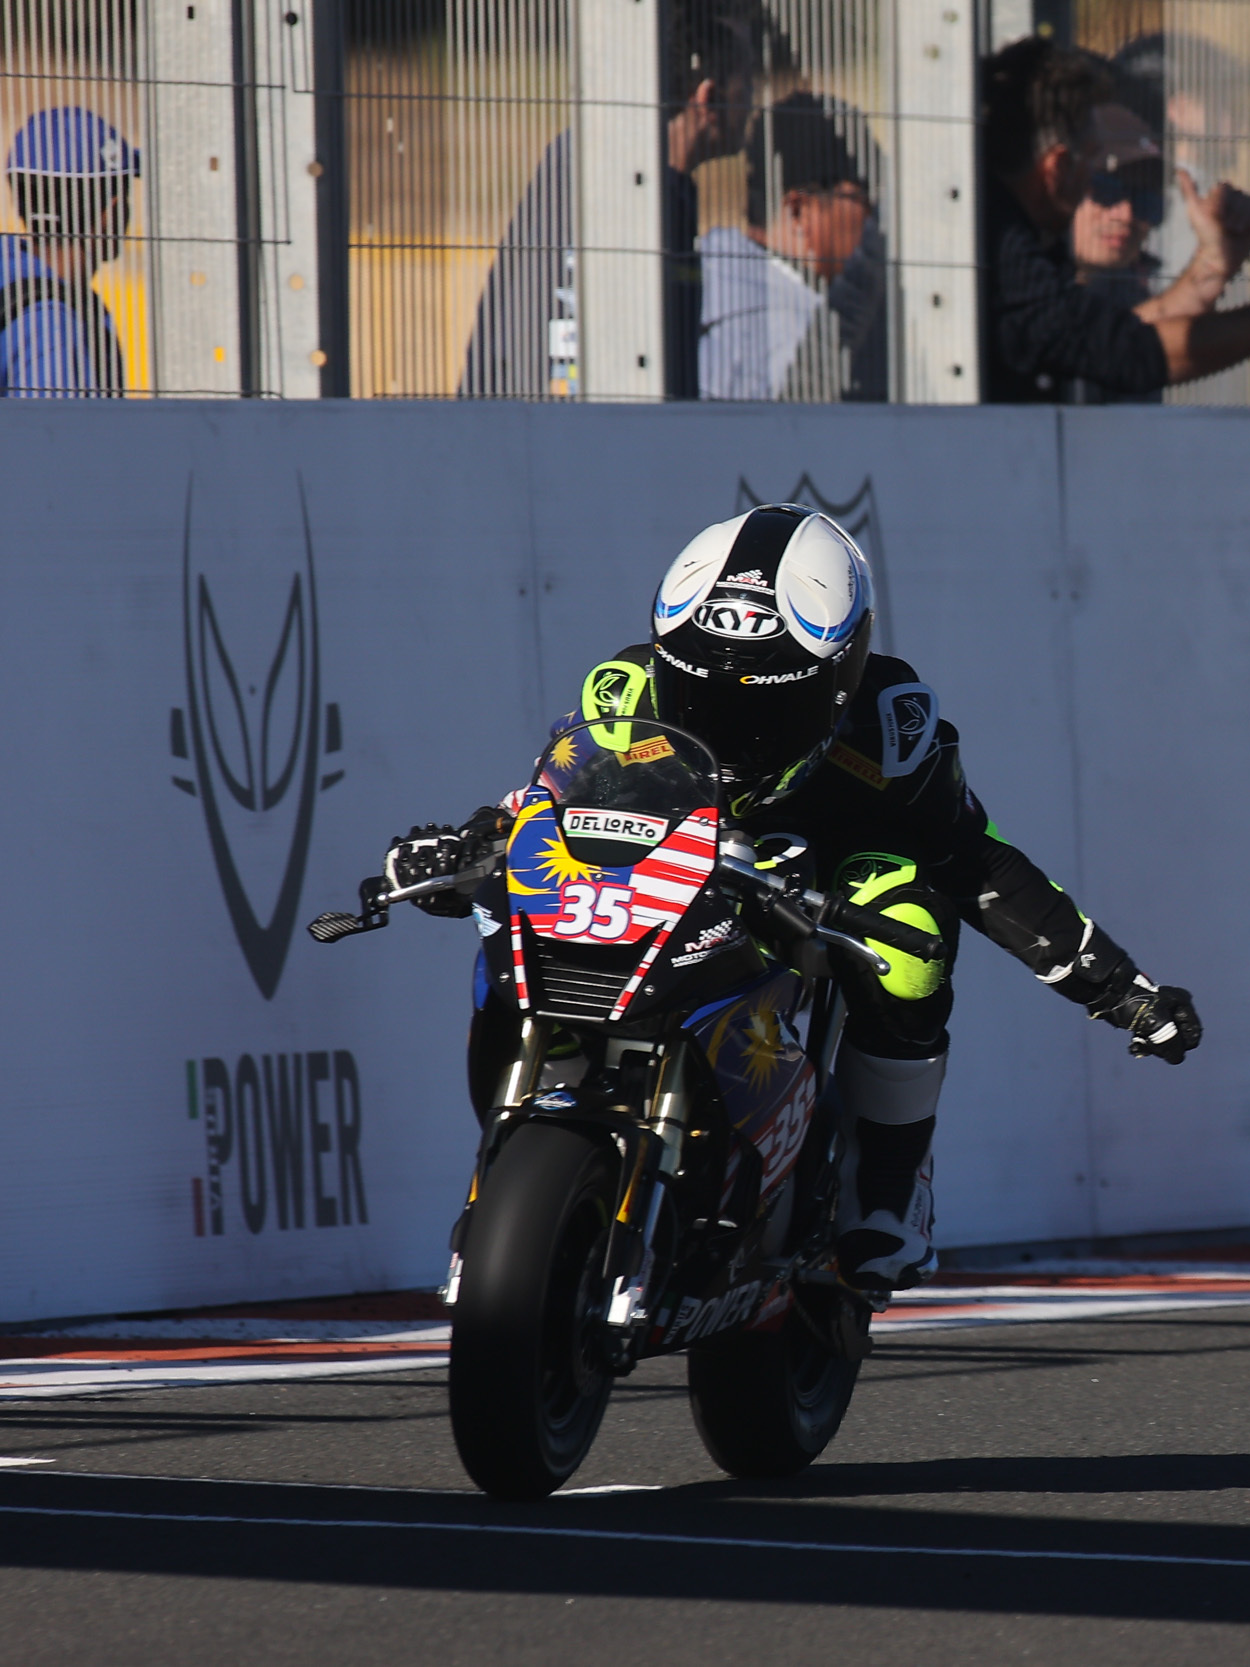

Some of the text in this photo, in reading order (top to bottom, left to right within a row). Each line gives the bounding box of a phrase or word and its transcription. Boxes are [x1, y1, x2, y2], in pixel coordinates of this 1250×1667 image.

[701, 604, 780, 634] KYT
[739, 664, 819, 685] OHVALE
[570, 814, 656, 840] DELLORTO
[552, 883, 633, 940] 35
[202, 1049, 370, 1237] POWER
[661, 1279, 763, 1346] POWER
